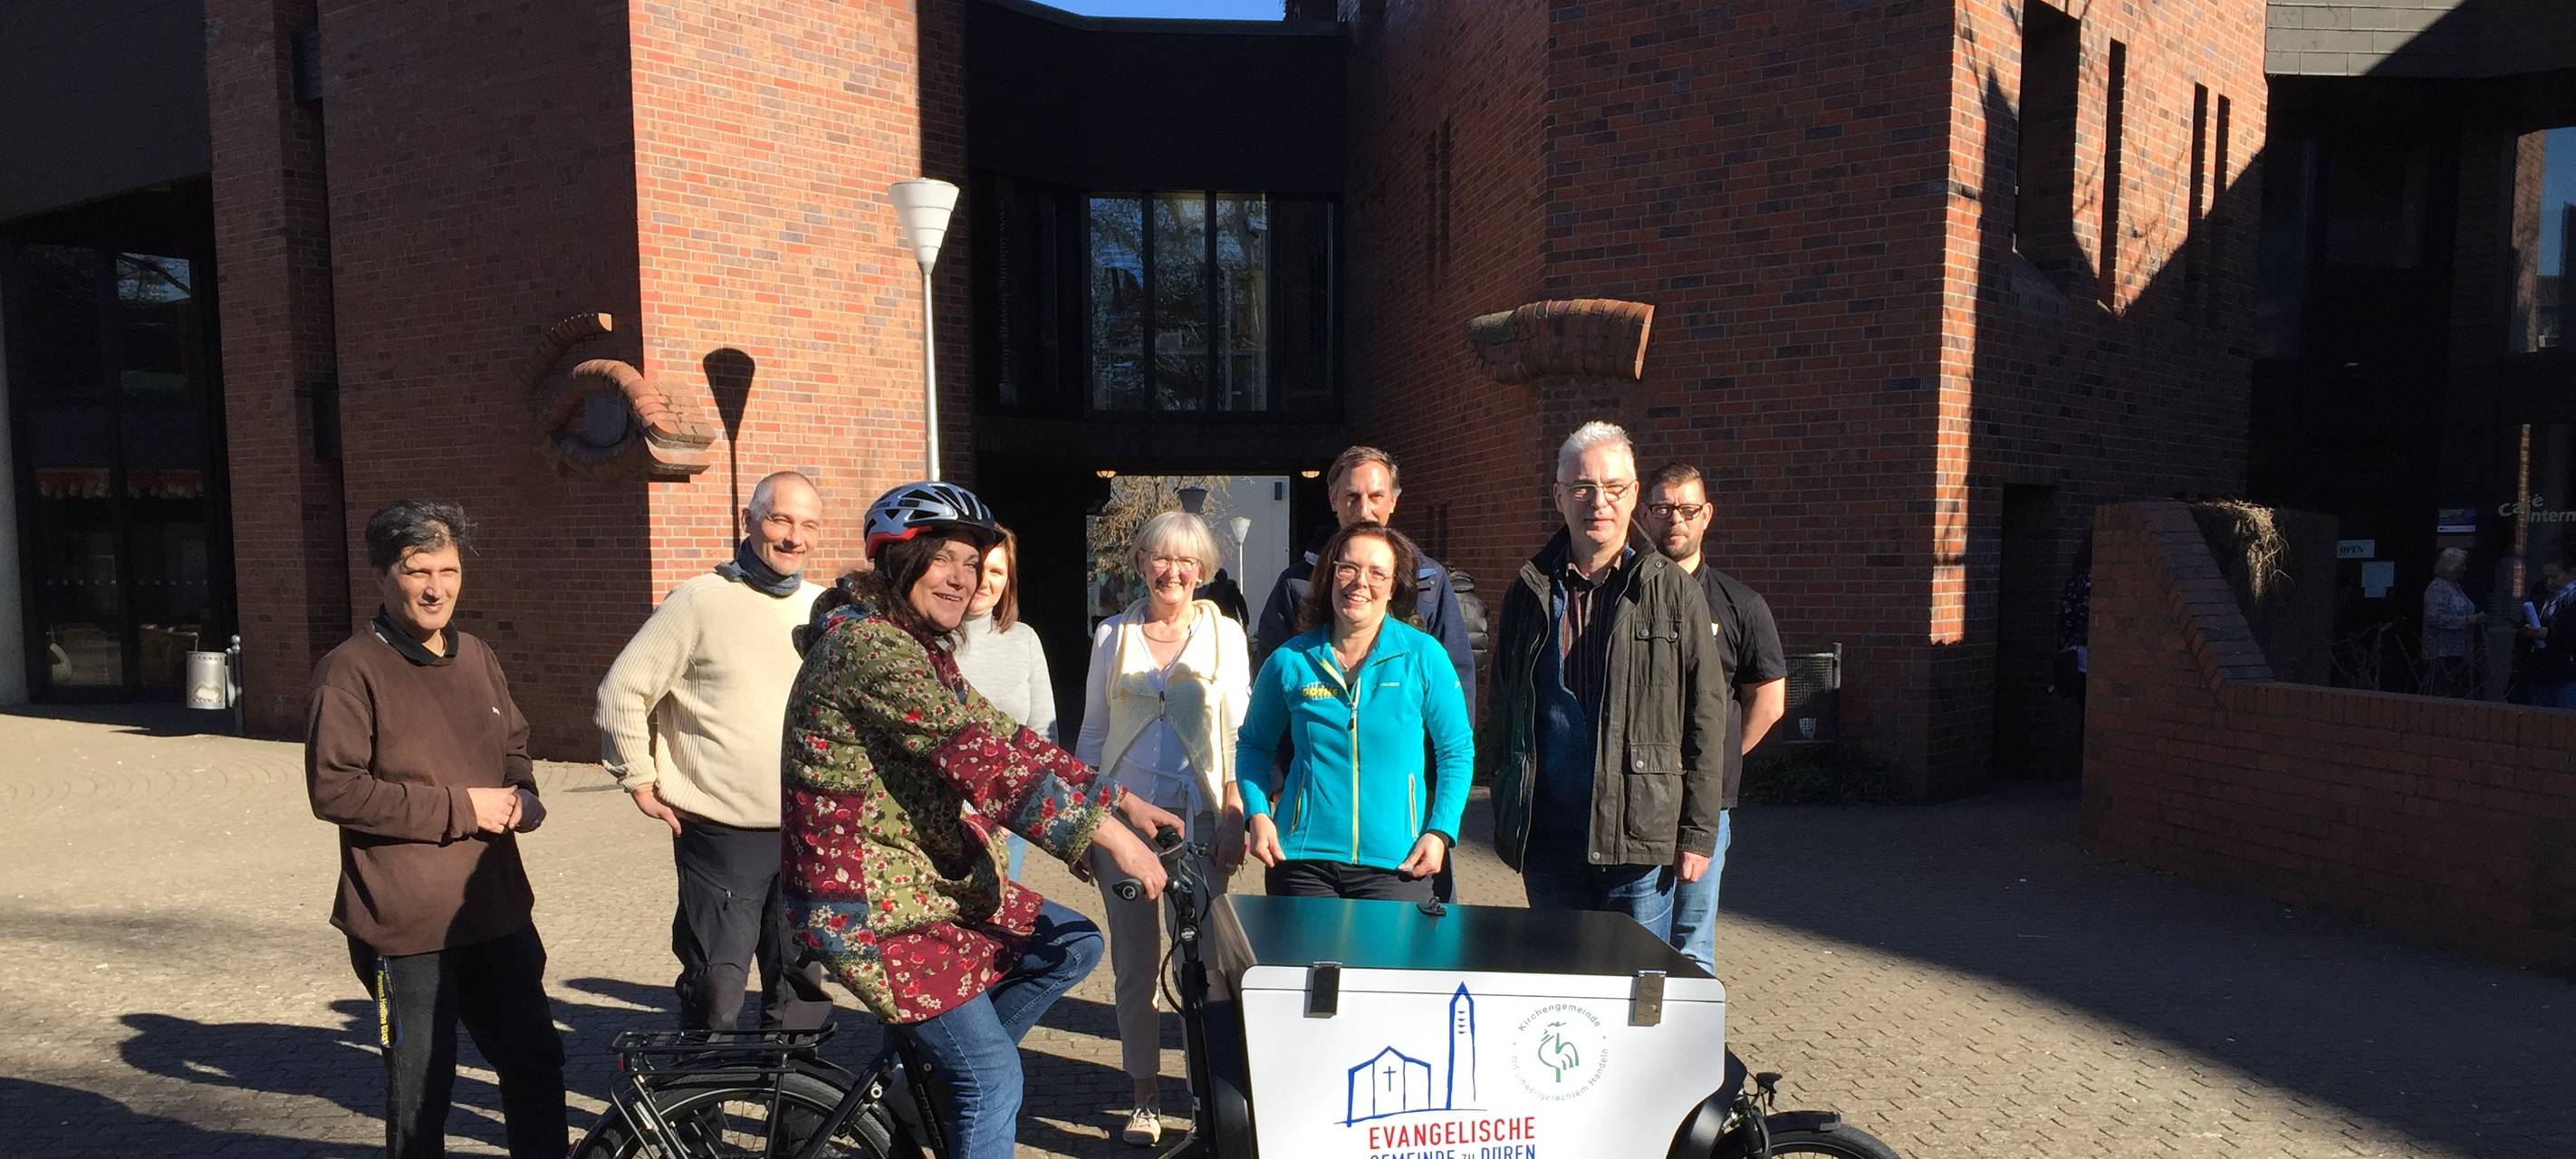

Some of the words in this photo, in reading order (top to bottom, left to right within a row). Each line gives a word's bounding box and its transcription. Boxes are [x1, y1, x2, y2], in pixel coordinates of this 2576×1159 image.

[1518, 1003, 1600, 1031] Kirchengemeinde
[1588, 1049, 1609, 1087] Handeln
[1370, 1116, 1535, 1150] EVANGELISCHE
